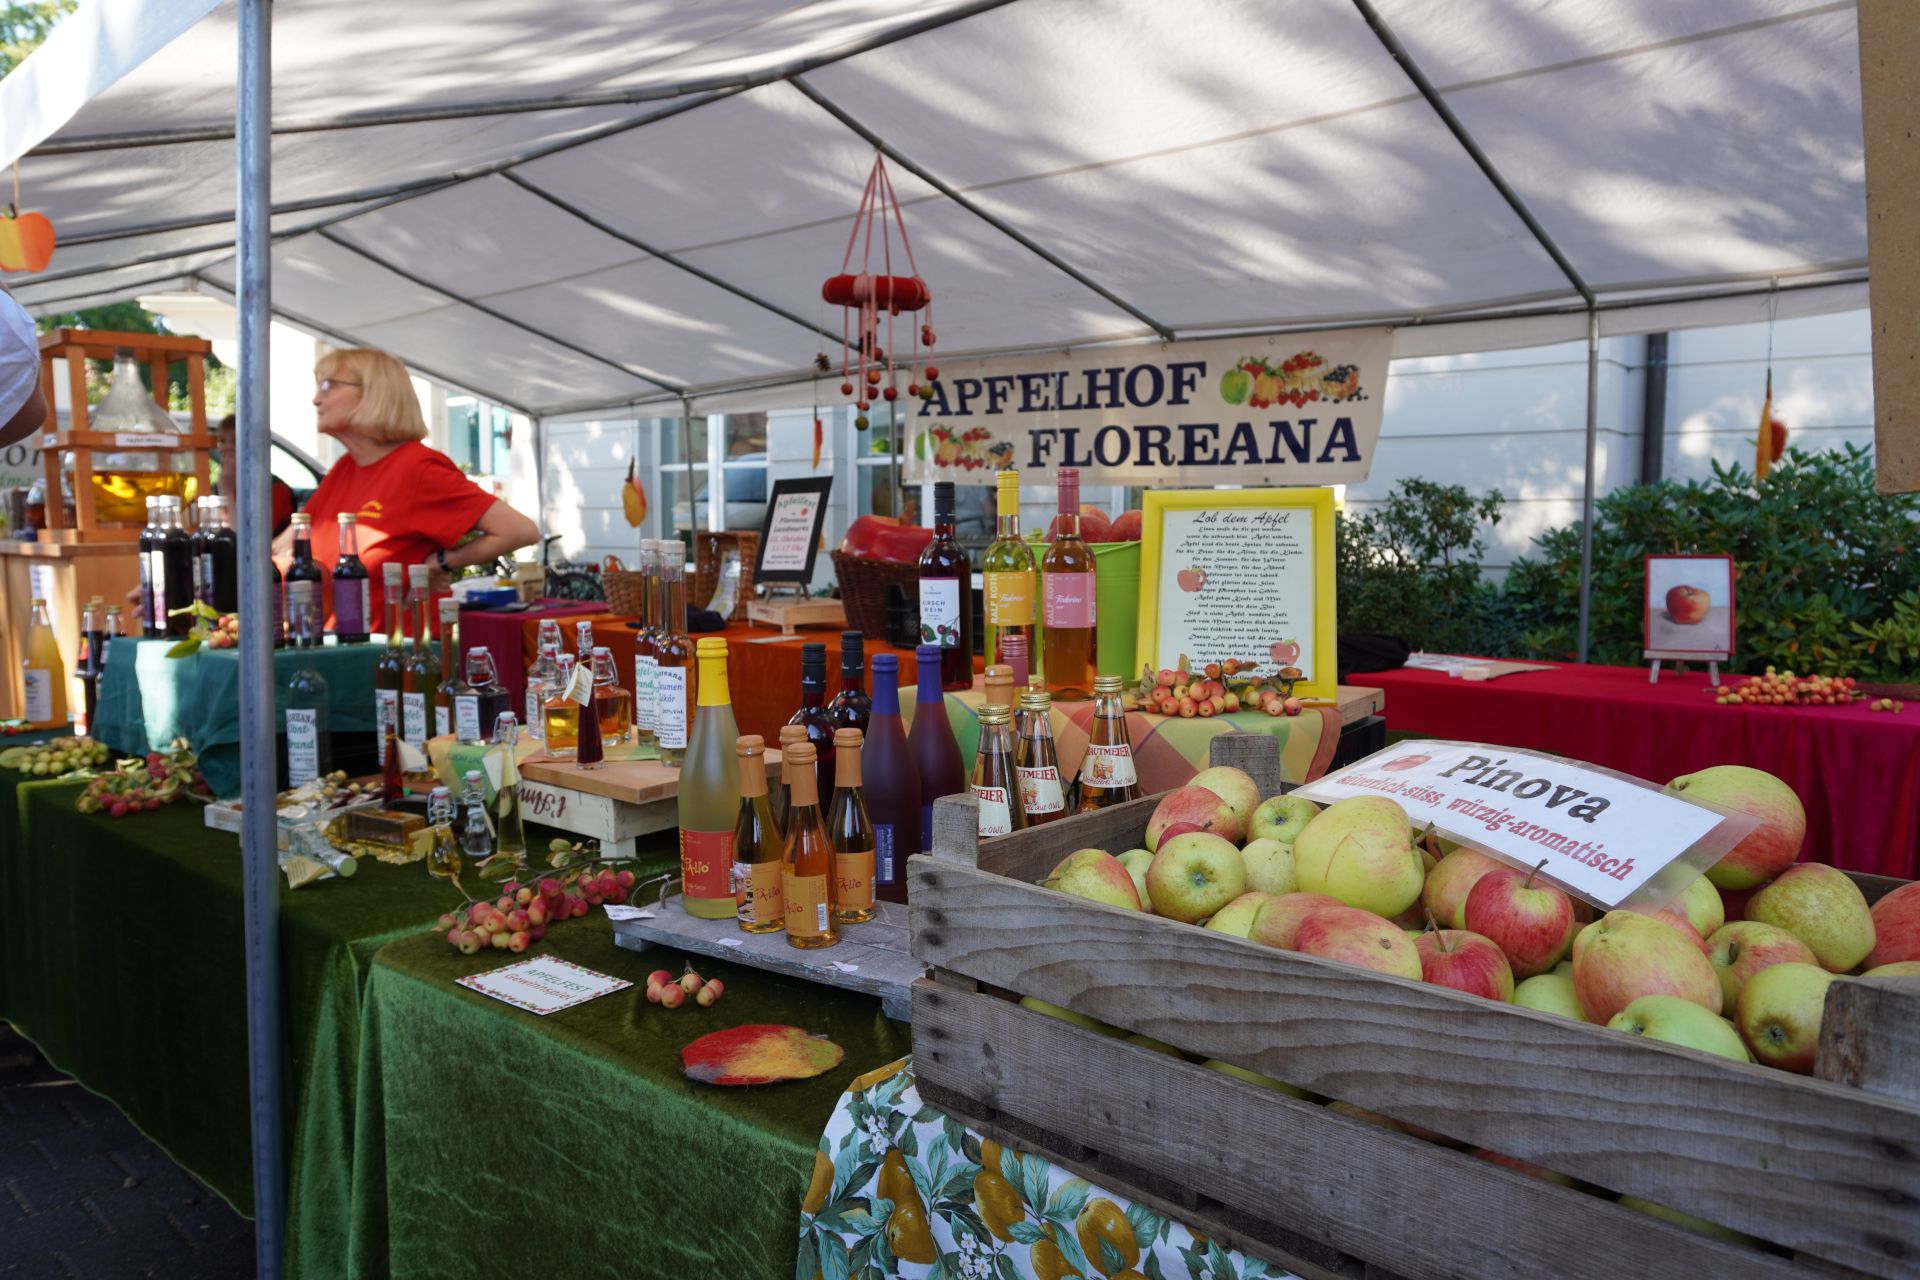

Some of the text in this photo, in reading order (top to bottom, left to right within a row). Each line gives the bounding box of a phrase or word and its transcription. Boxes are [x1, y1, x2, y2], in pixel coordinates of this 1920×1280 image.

[917, 362, 1206, 416] APFELHOF
[1027, 417, 1362, 467] FLOREANA
[1192, 512, 1291, 527] Lob dem Apfel
[1436, 755, 1611, 824] Pinova
[1336, 774, 1636, 881] säuerlich-süss, würzig-aromatisch
[504, 973, 578, 1000] Gewinnspiel
[523, 969, 593, 993] APFELFEST
